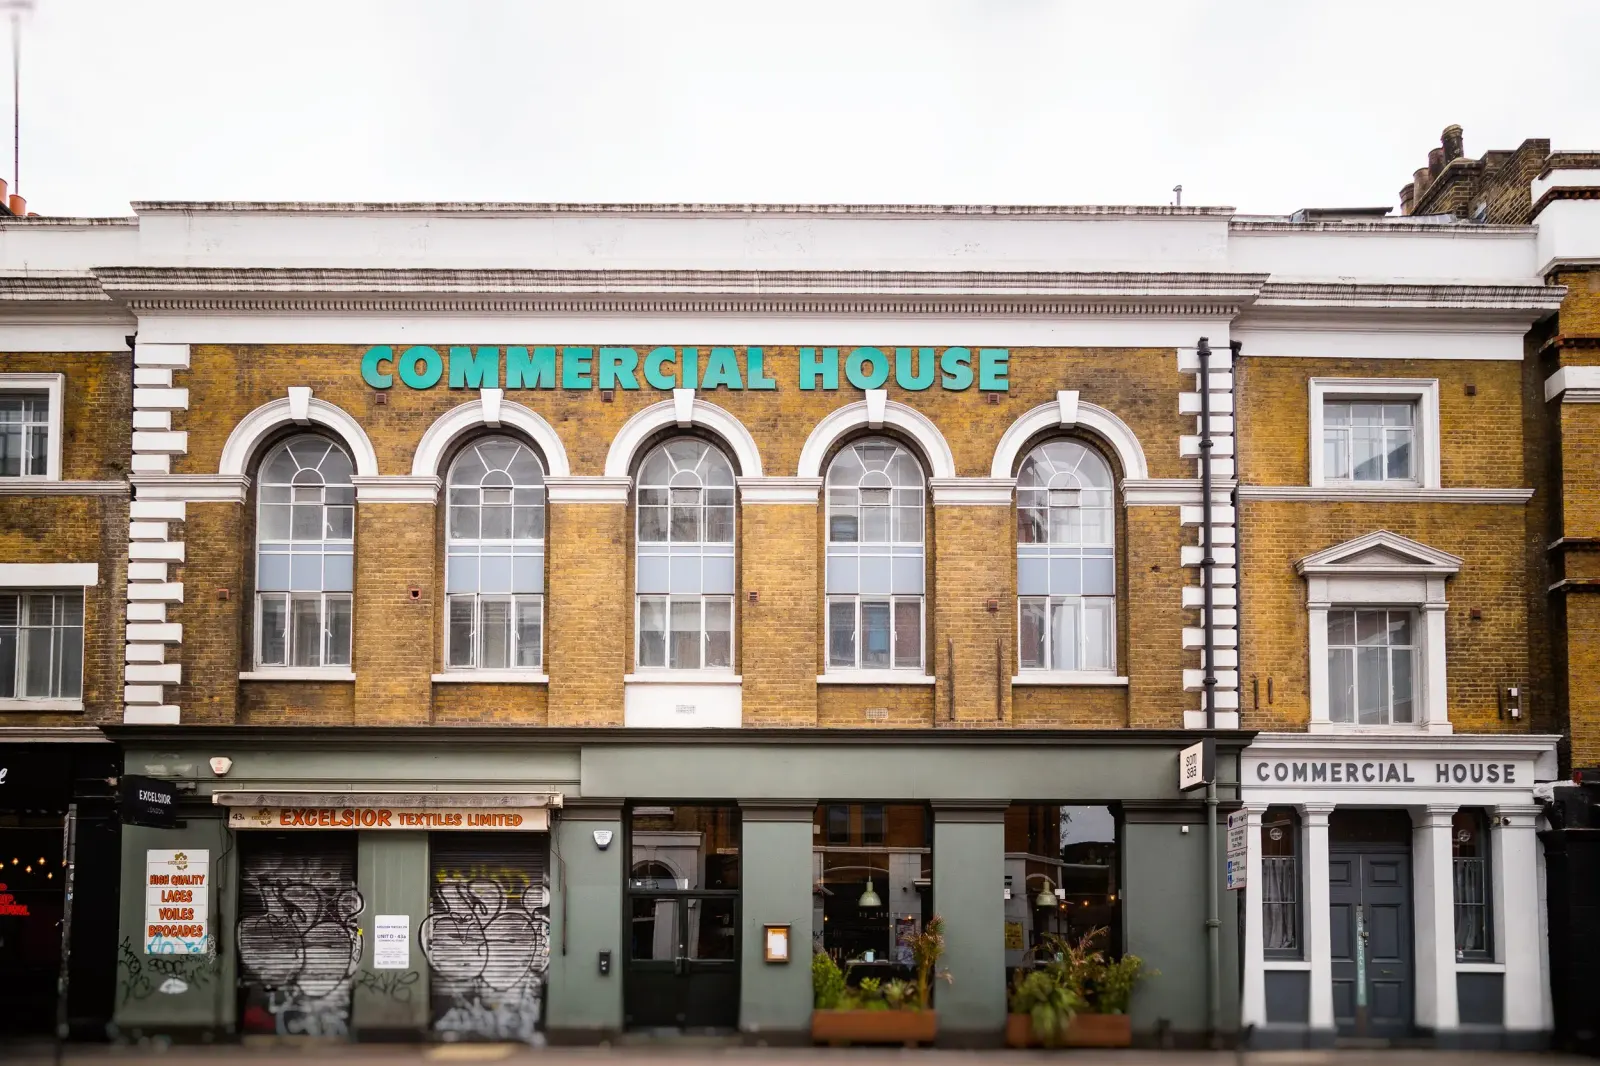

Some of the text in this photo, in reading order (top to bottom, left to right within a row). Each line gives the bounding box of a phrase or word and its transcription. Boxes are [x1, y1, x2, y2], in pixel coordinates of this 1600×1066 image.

[361, 345, 1009, 391] COMMERCIAL HOUSE
[1186, 753, 1197, 766] som
[1187, 765, 1197, 778] saa
[1256, 762, 1516, 784] COMMERCIAL HOUSE
[139, 789, 171, 804] EXCELSIOR
[279, 808, 523, 827] EXCELSIOR TEXTILES LIMITED
[150, 874, 205, 886] HIGH QUALITY
[161, 890, 192, 903] LACES
[159, 907, 194, 920] VOILES
[148, 924, 203, 938] BROCADES
